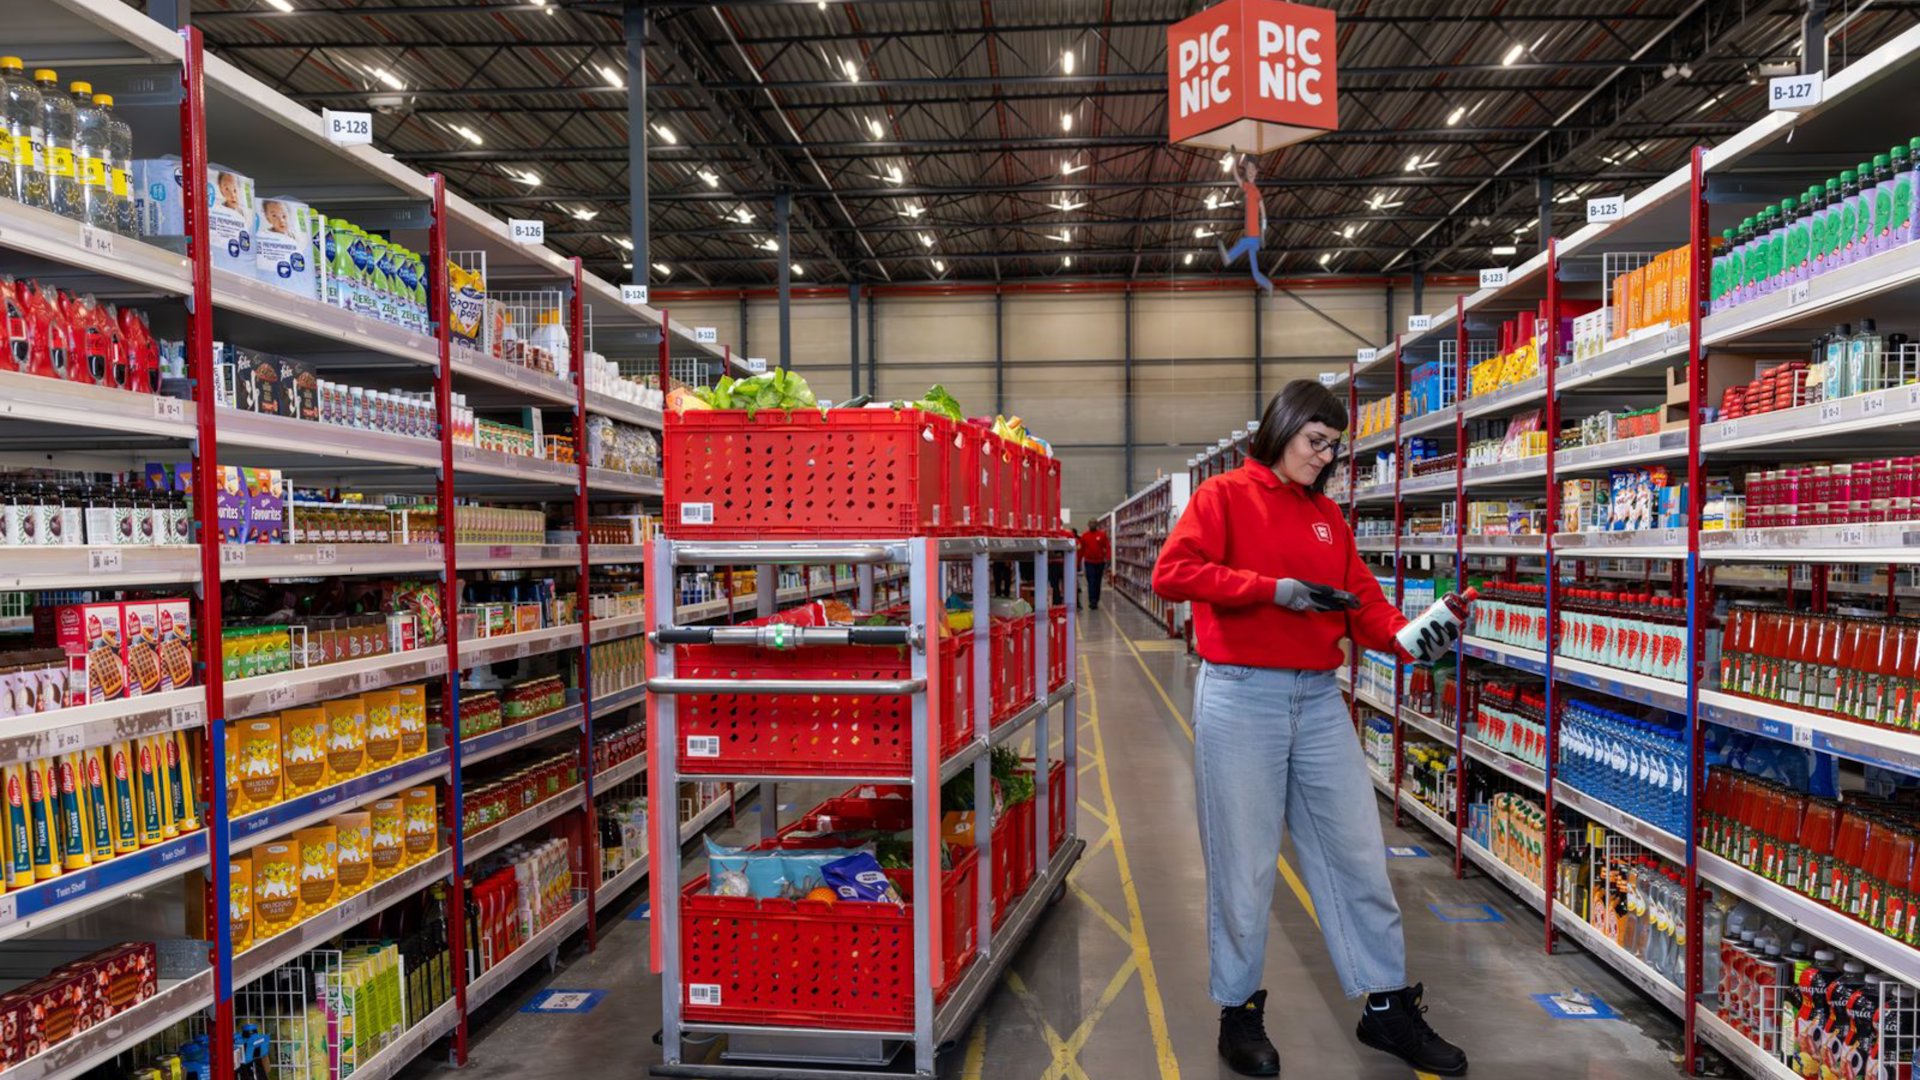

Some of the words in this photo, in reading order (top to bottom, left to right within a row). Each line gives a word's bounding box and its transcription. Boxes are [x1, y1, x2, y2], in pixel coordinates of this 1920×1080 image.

[1258, 20, 1322, 66] PIC
[1179, 24, 1230, 79] PIC
[1774, 83, 1812, 100] B-127
[333, 119, 368, 134] B-128
[1590, 204, 1617, 216] B-125
[515, 226, 541, 237] B-126
[1482, 273, 1503, 284] B-123
[625, 290, 645, 300] B-124
[71, 811, 79, 837] FRANSE
[20, 826, 28, 853] FRANSE
[162, 851, 173, 861] Twin
[173, 846, 187, 858] Shelf
[56, 887, 71, 898] Twin
[71, 880, 86, 894] Shelf
